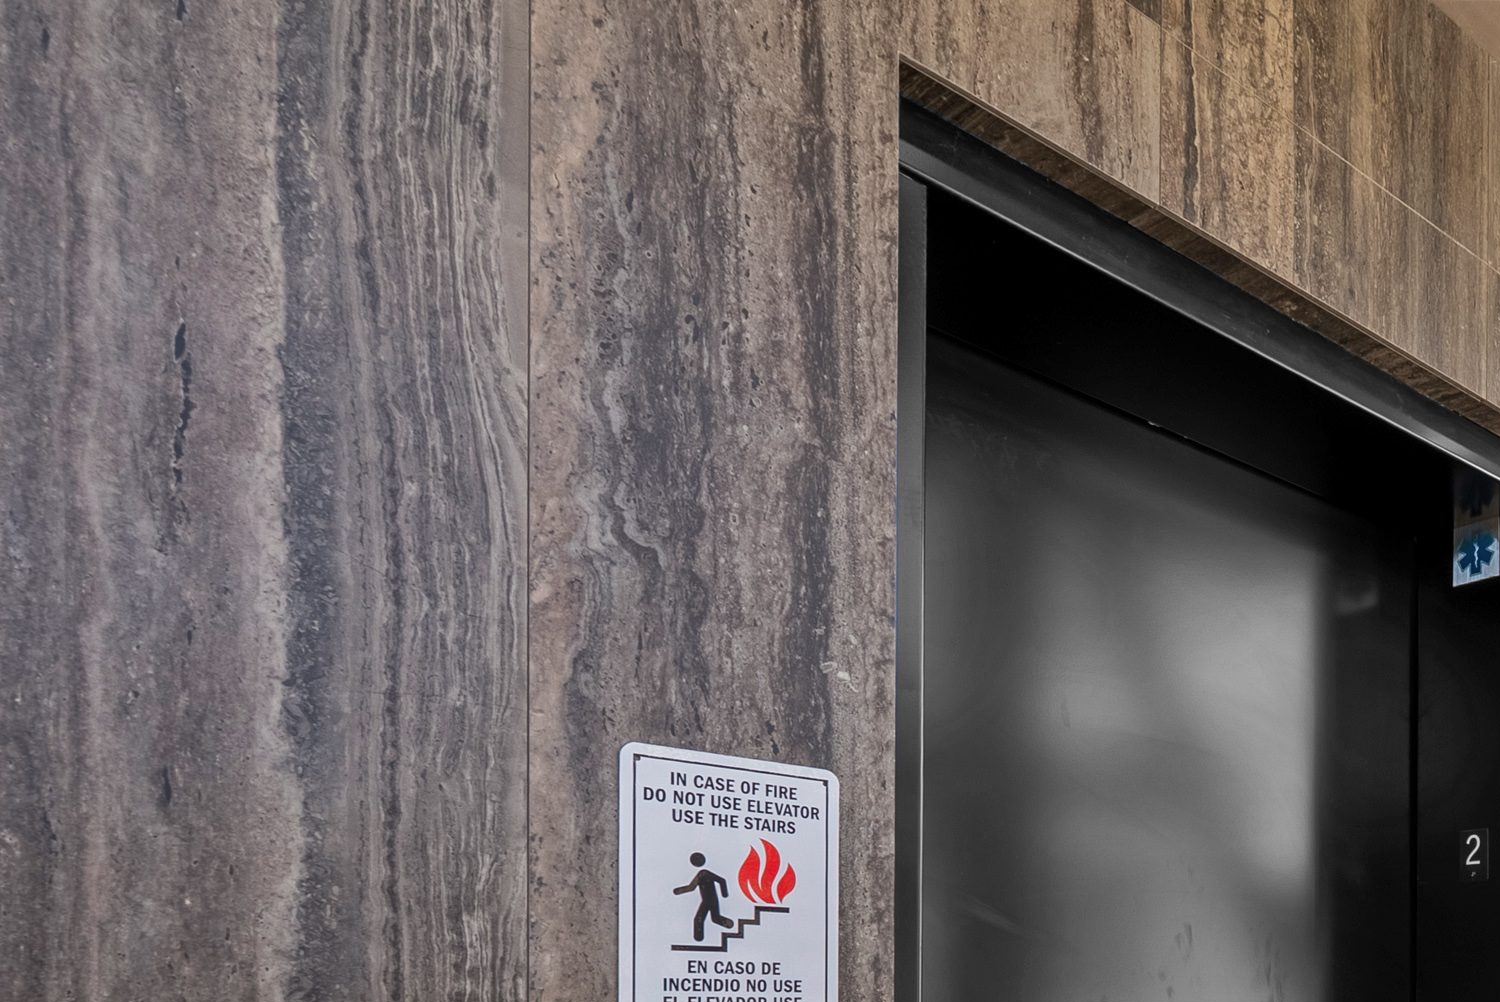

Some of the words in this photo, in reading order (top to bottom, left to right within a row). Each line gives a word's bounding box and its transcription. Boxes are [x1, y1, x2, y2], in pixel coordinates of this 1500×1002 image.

[670, 771, 687, 787] IN
[693, 774, 735, 793] CASE
[740, 781, 760, 796] OF
[766, 784, 798, 801] FIRE
[643, 786, 666, 803] DO
[673, 790, 705, 807] NOT
[710, 794, 742, 812] USE
[747, 799, 820, 820] ELEVATOR
[672, 808, 704, 825] USE
[709, 812, 739, 829] THE
[744, 816, 796, 834] STAIRS
[1466, 834, 1480, 866] 2
[687, 960, 708, 974] EN
[714, 961, 756, 975] CASO
[761, 962, 781, 976] DE
[663, 978, 740, 992] INCENDIO
[746, 980, 767, 992] NO
[773, 980, 802, 993] USE
